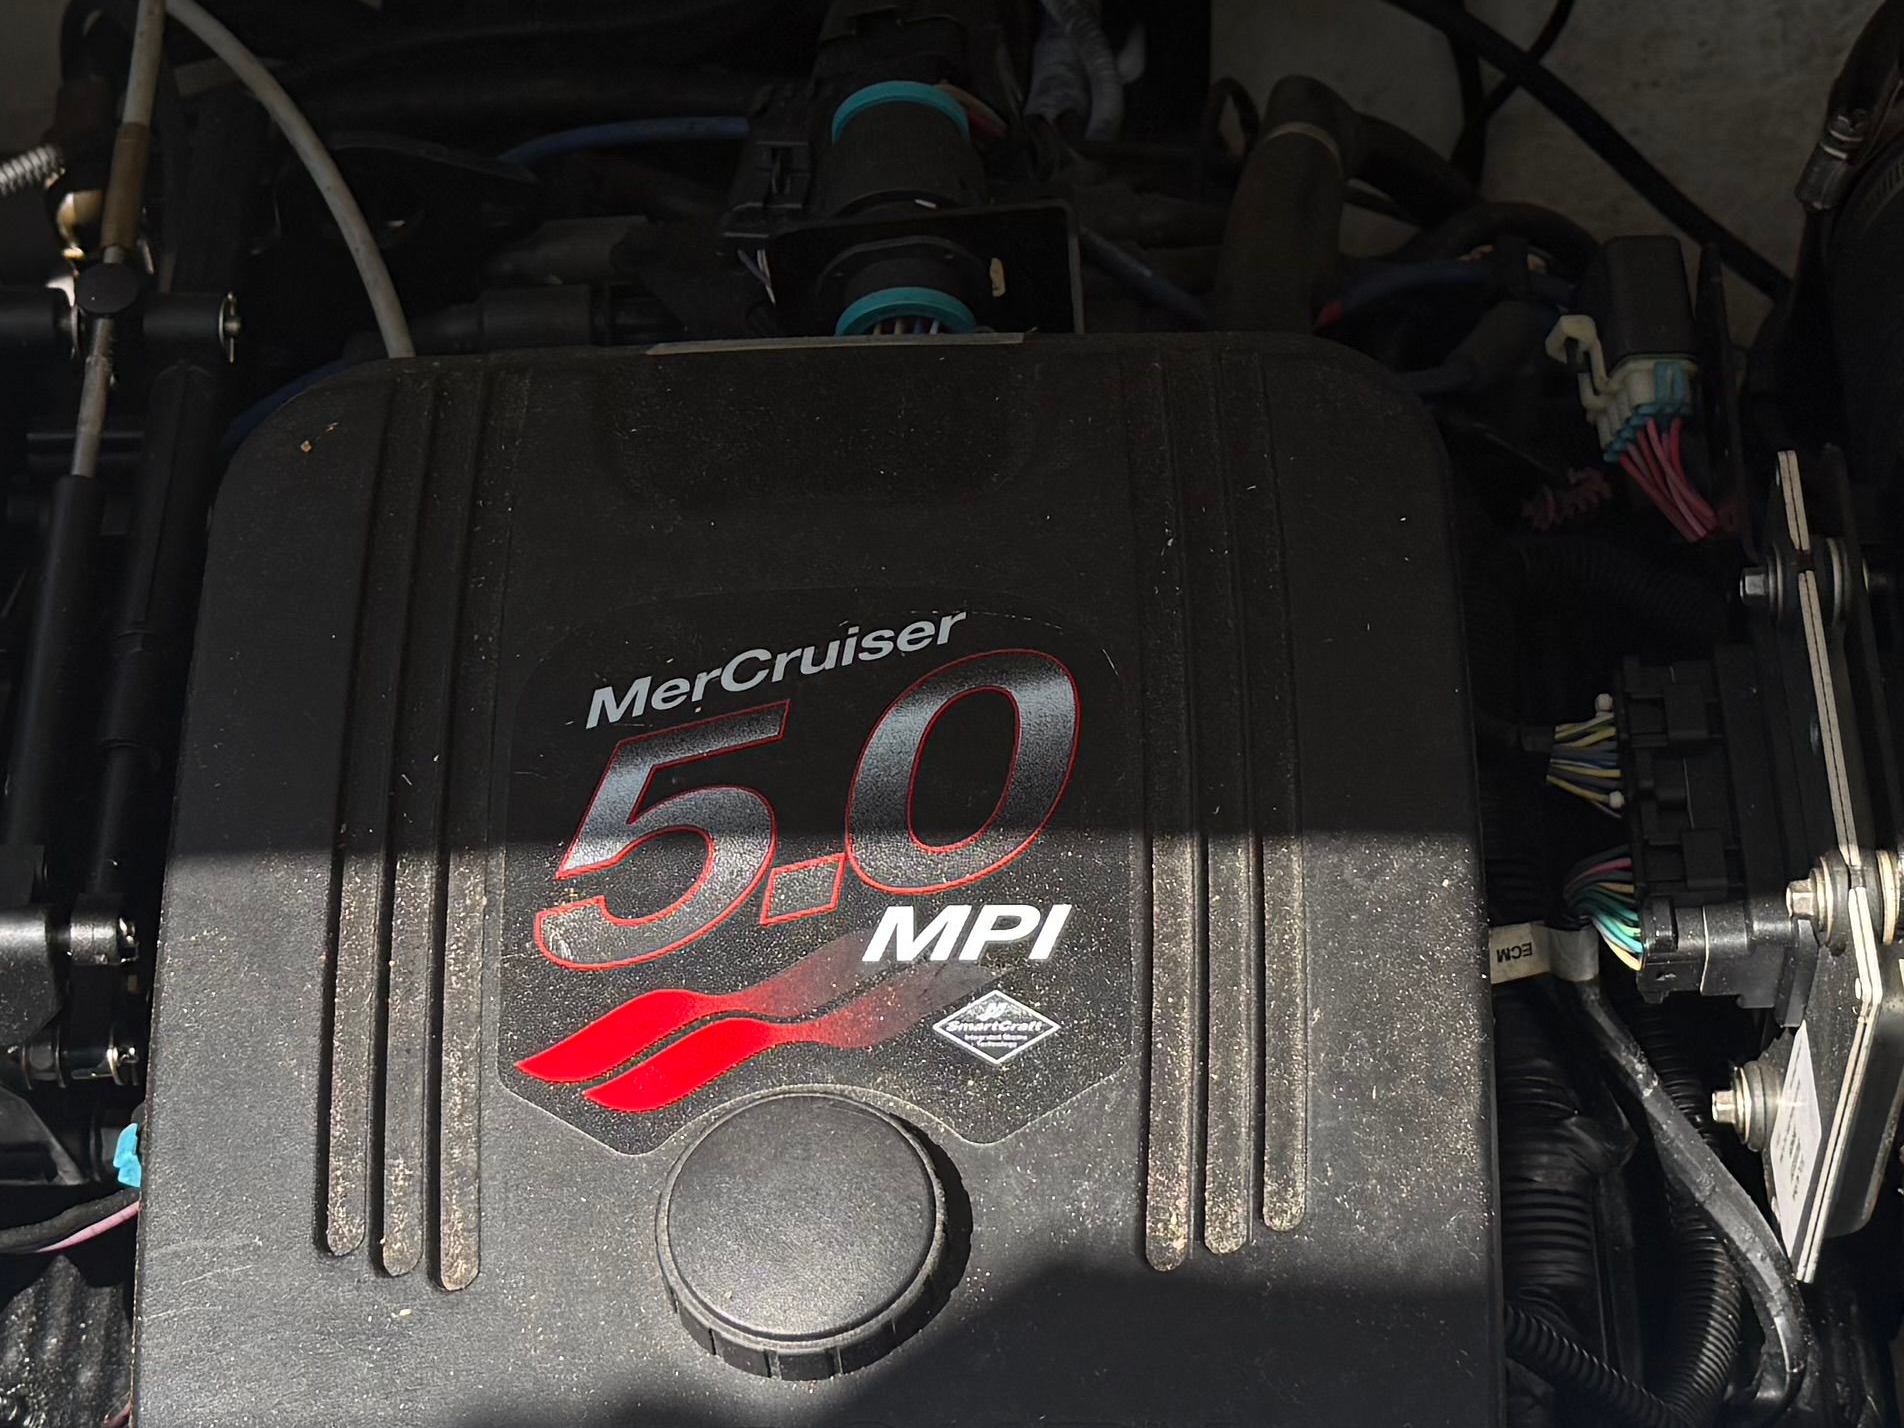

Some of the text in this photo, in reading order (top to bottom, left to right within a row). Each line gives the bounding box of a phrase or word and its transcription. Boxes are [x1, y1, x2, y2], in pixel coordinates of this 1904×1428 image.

[584, 612, 967, 731] MerCruiser
[533, 647, 1082, 971] 5.0
[861, 903, 1073, 964] MPI
[1496, 942, 1533, 963] ECM
[945, 1020, 1043, 1033] SmartCraft
